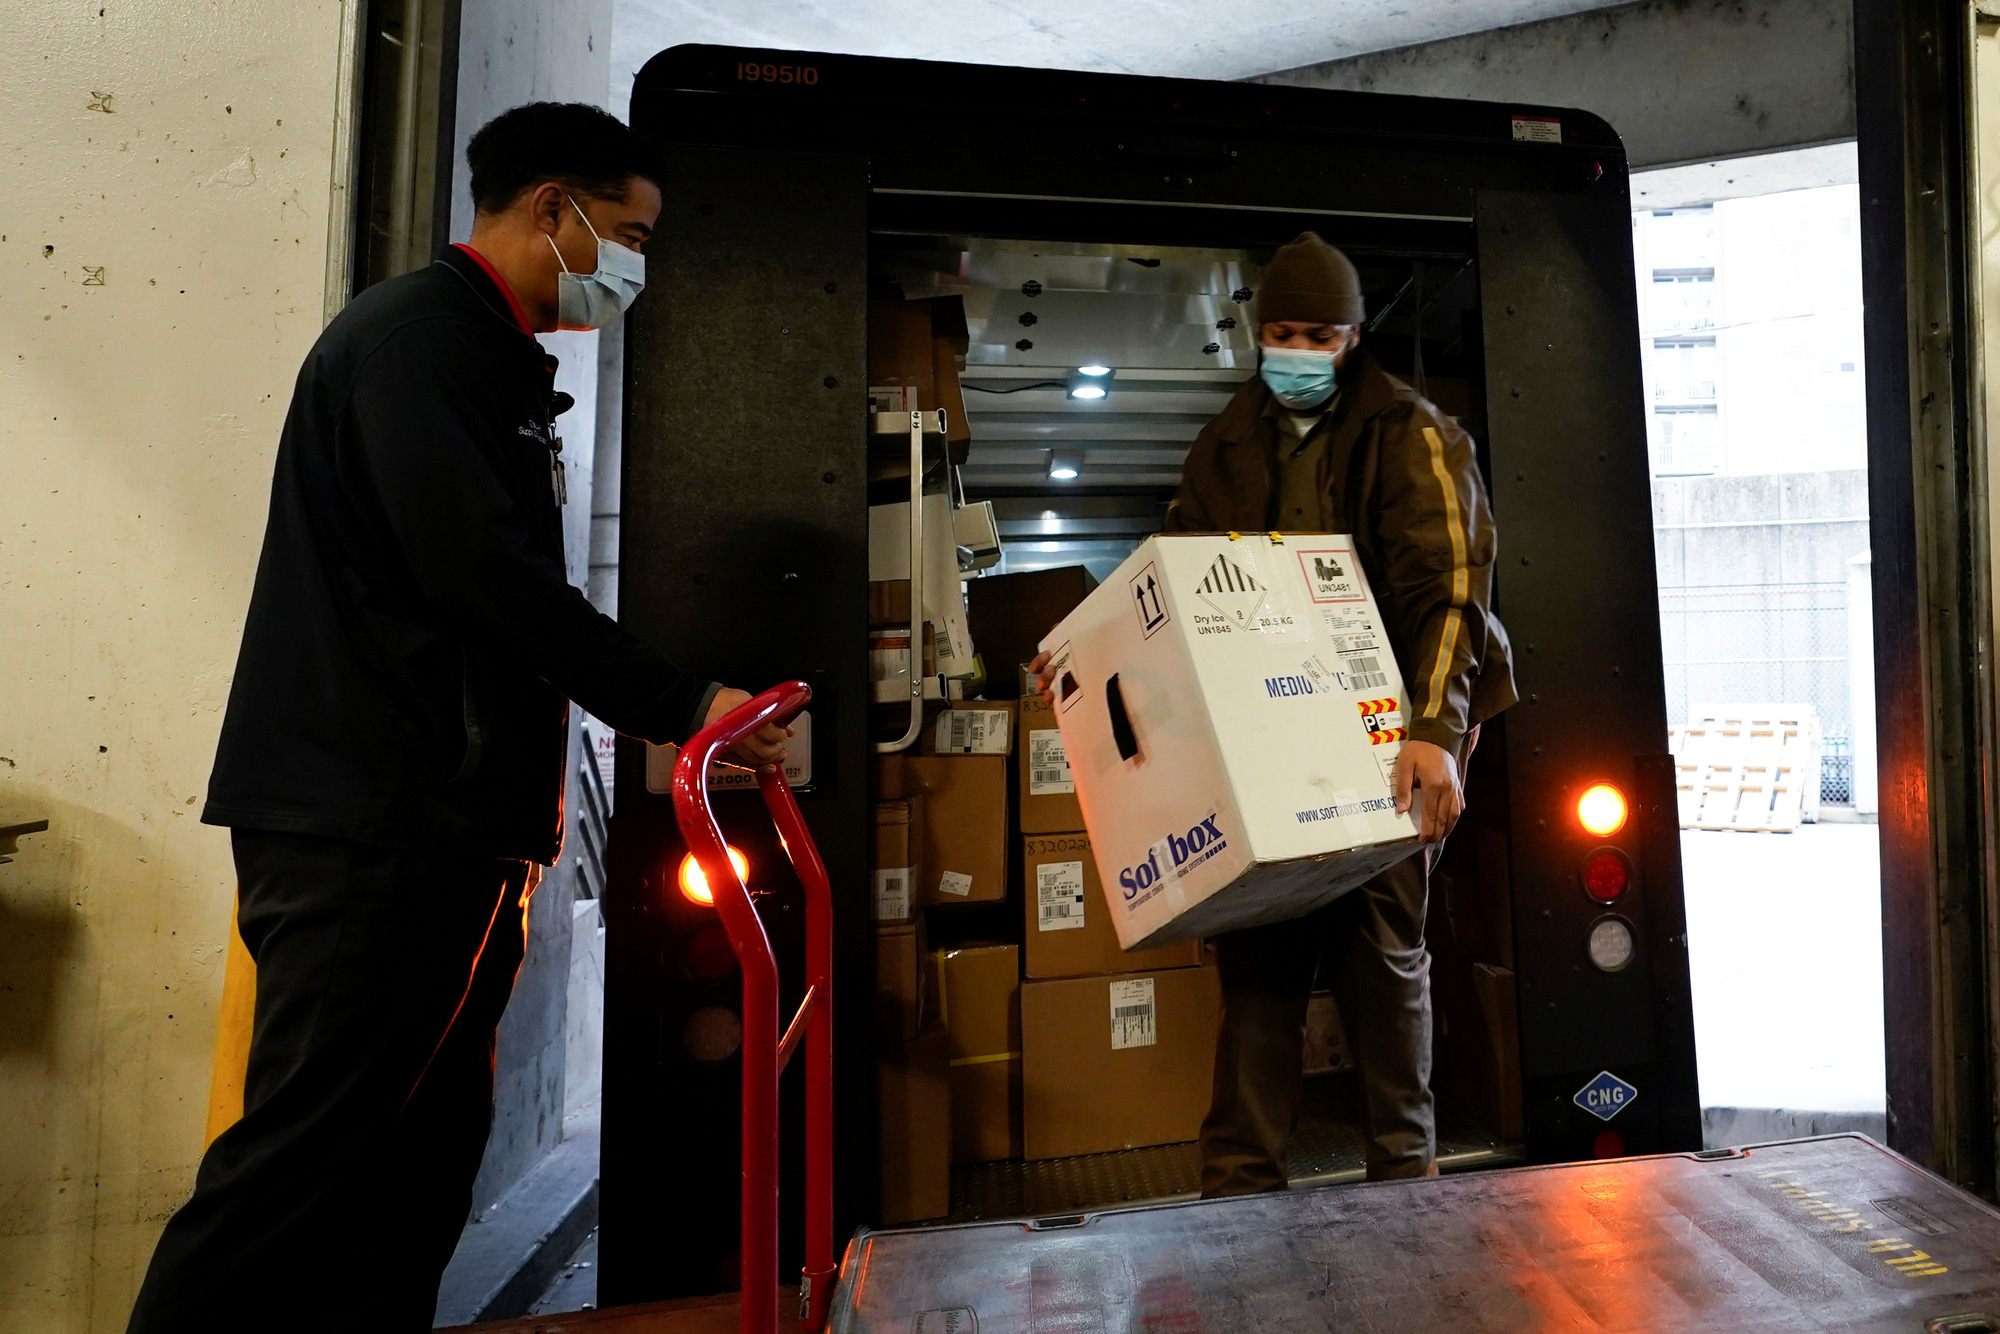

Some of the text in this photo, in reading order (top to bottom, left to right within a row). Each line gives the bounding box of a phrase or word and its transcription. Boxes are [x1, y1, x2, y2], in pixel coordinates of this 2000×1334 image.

[737, 62, 819, 85] 199510
[1317, 583, 1351, 593] UN3481
[1193, 614, 1225, 625] Dry Ice
[1281, 616, 1294, 625] KG
[1197, 625, 1232, 635] UN1845
[1264, 675, 1318, 698] MEDIU
[1362, 715, 1377, 732] P
[599, 736, 615, 749] N
[1027, 840, 1091, 856] 832022
[1118, 813, 1224, 901] Softbox
[1587, 1086, 1624, 1107] CNG
